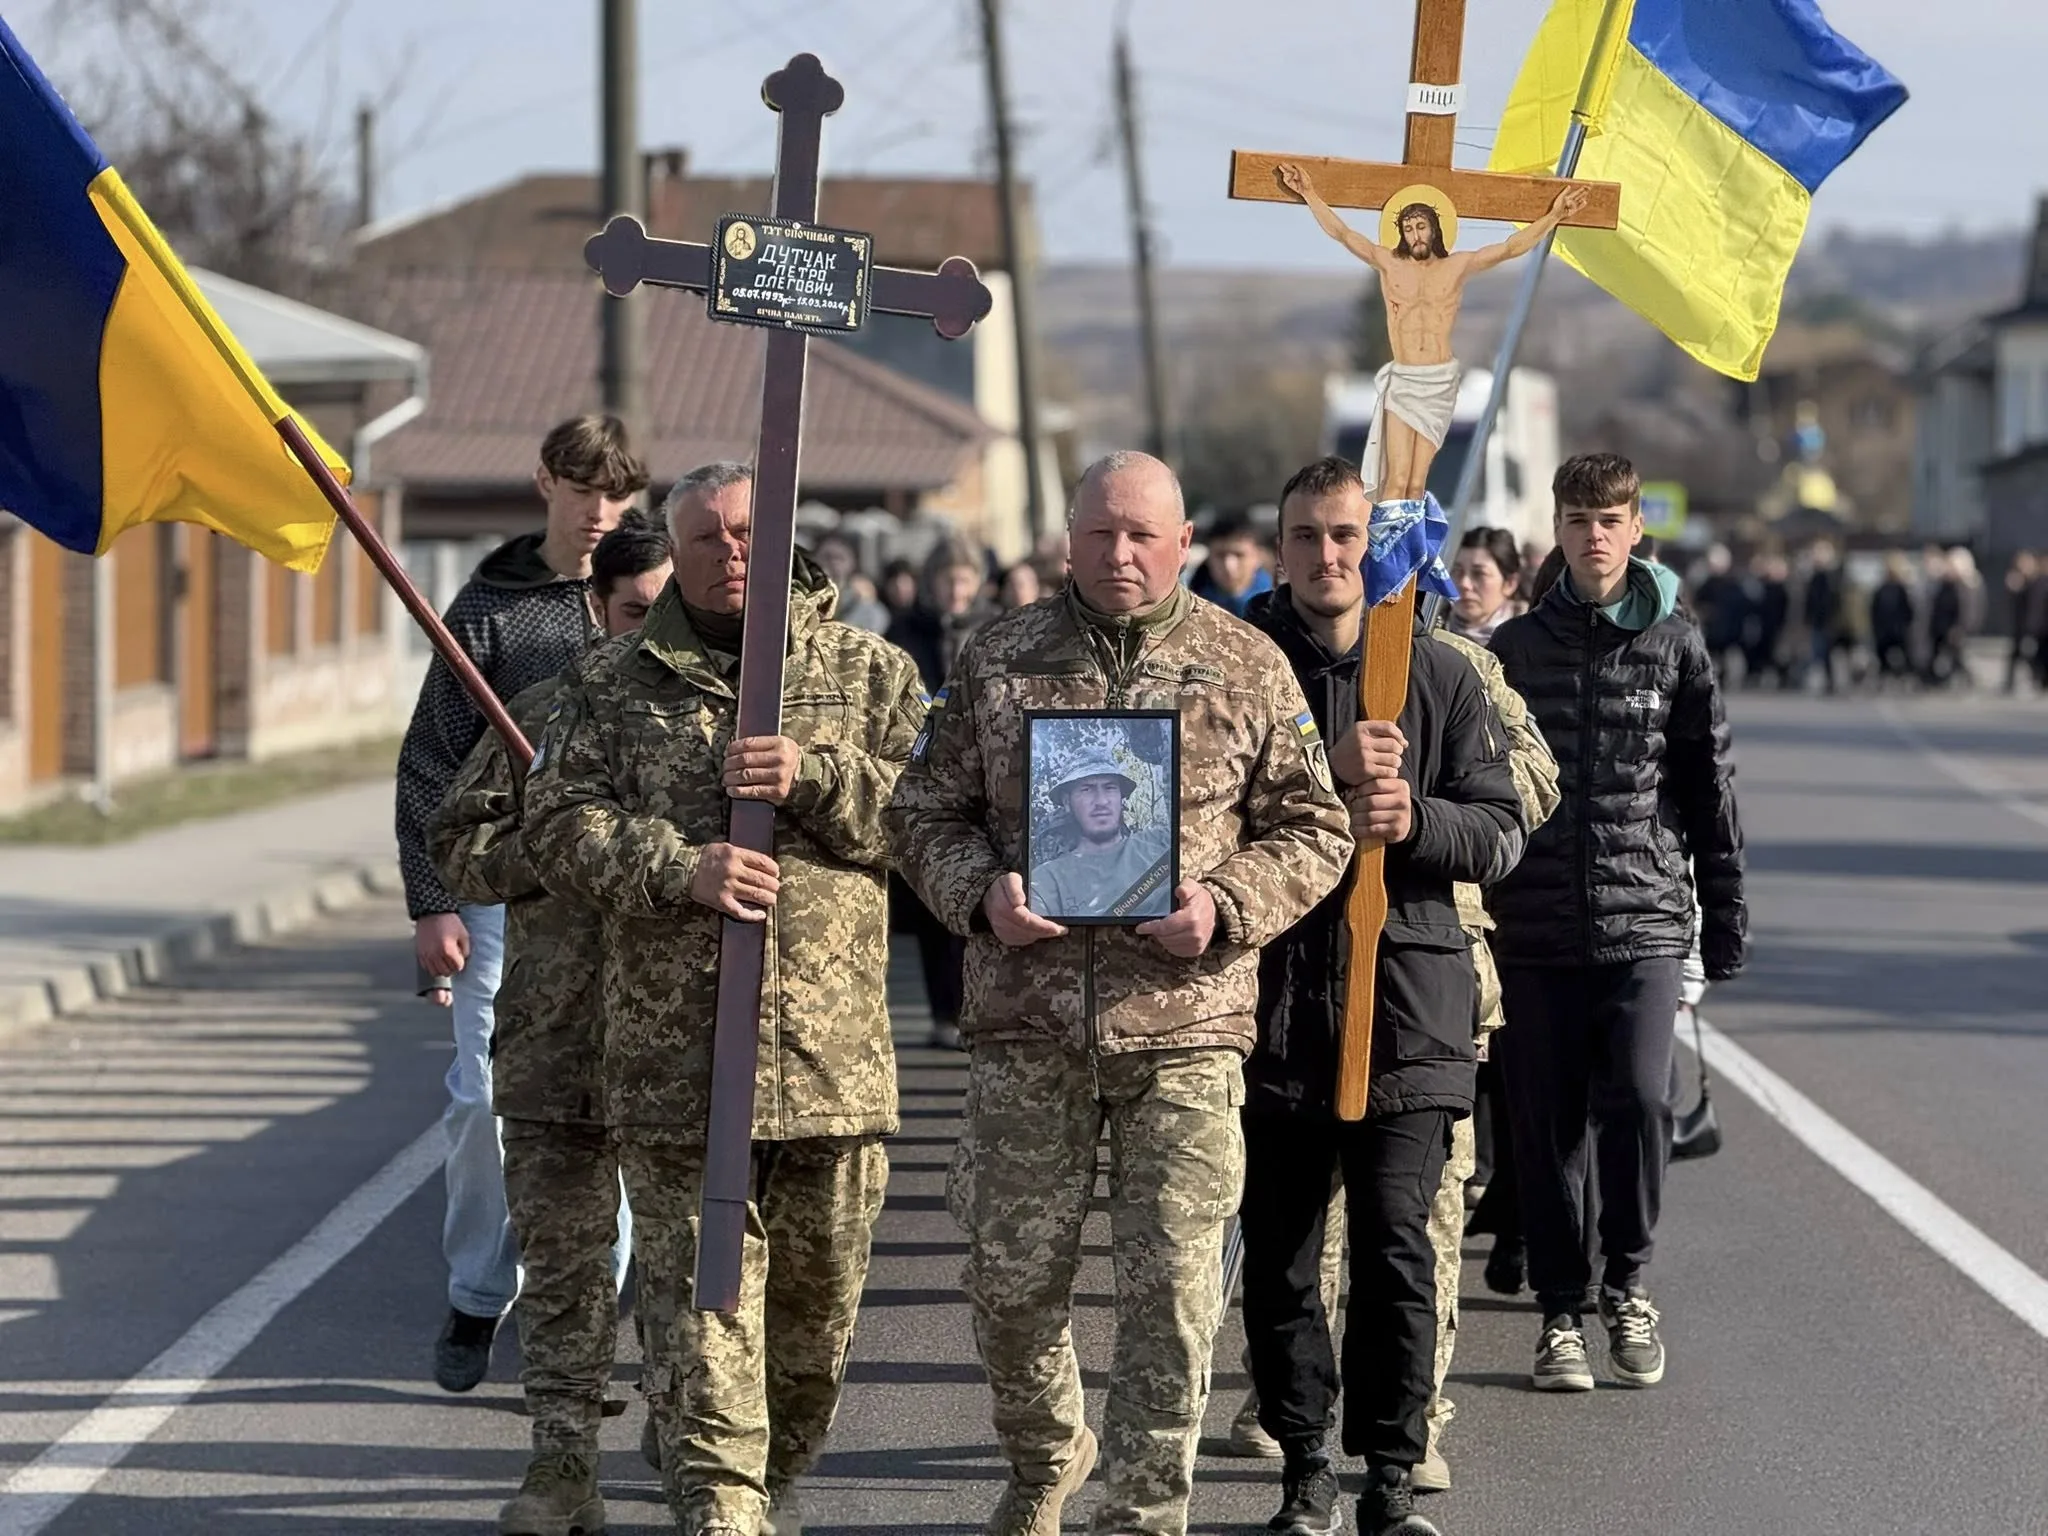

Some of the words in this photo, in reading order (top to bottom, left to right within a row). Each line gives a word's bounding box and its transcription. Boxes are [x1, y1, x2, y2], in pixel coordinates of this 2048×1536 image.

[762, 225, 782, 235] ТУТ
[757, 244, 837, 270] ДУТЧАК
[775, 265, 827, 282] ПЕТРО
[754, 274, 834, 297] ОЛЕГОВИЧ
[1113, 893, 1139, 917] Вічна
